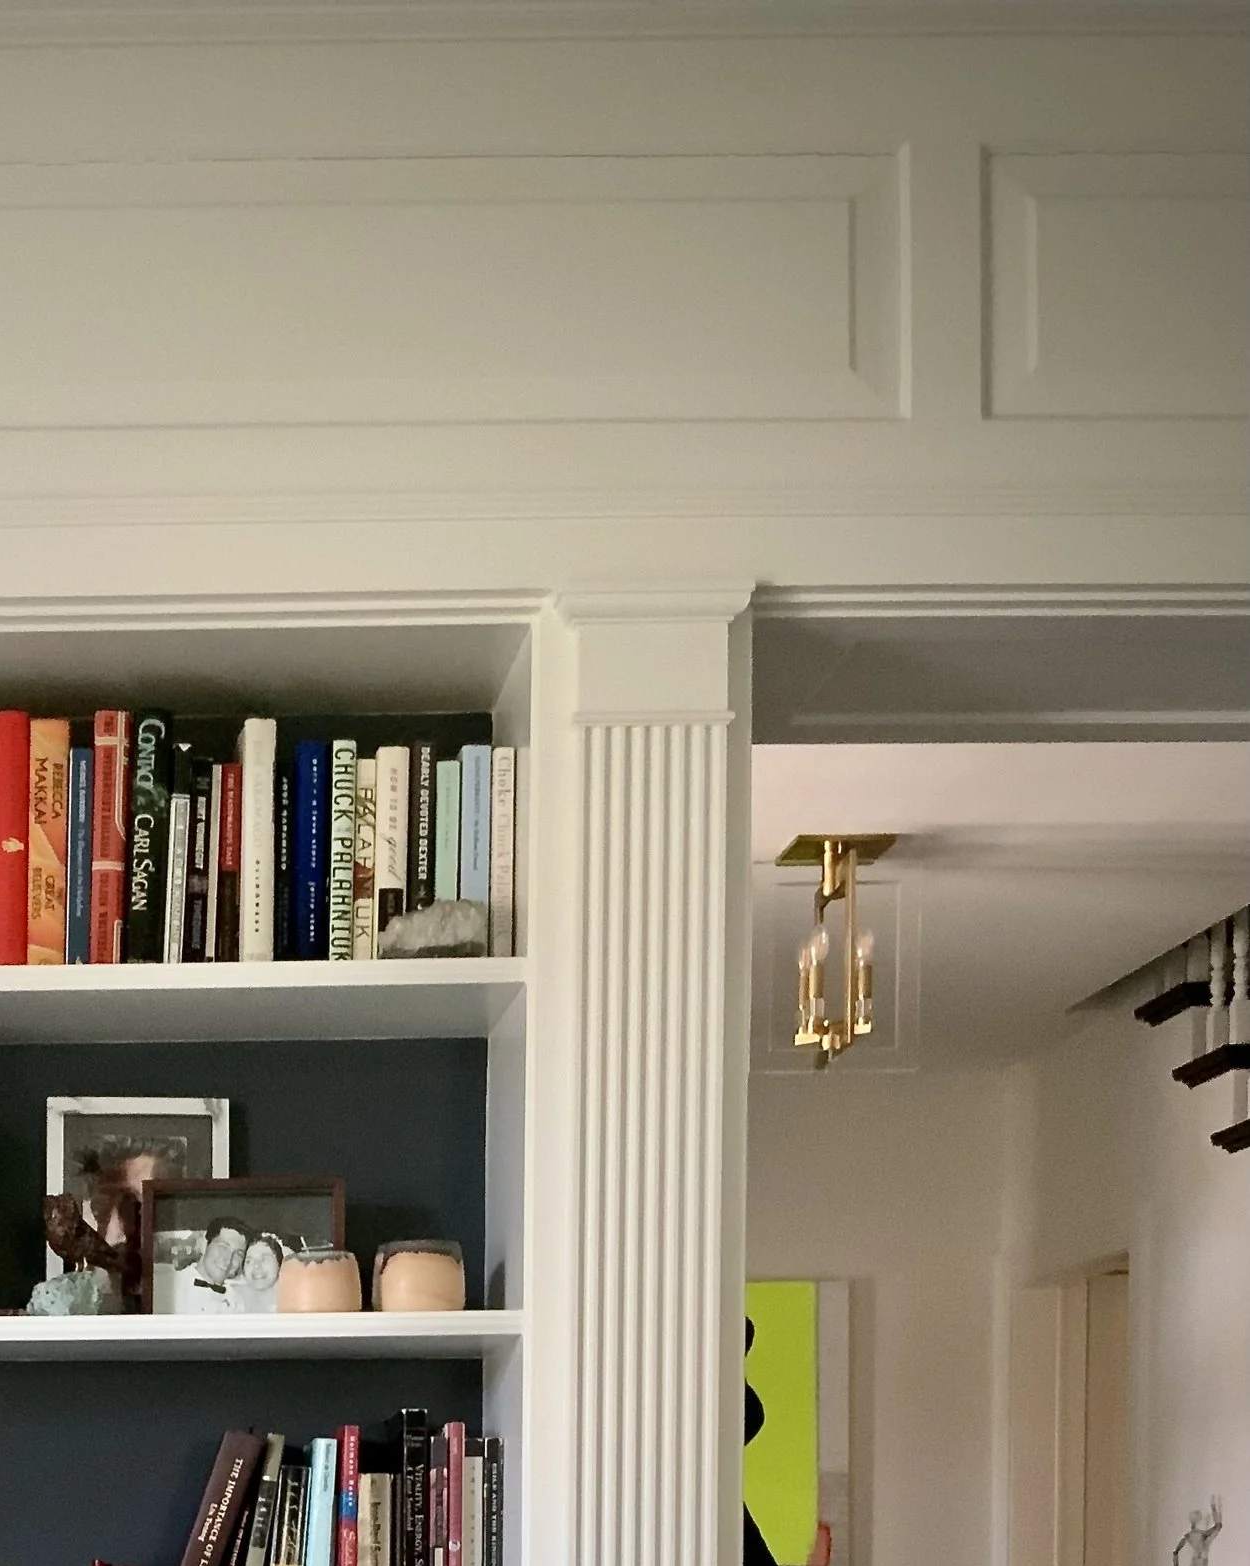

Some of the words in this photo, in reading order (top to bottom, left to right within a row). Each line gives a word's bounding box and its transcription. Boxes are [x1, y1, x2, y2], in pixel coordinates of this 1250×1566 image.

[333, 748, 355, 821] CHUCK
[420, 746, 430, 786] DEARLY
[497, 756, 512, 807] Choke
[34, 757, 48, 825] MAKKAI
[51, 763, 63, 819] REBECCA
[419, 789, 429, 836] DEVOTED
[133, 814, 154, 856] CARL
[418, 839, 428, 880] DEXTER
[45, 875, 55, 911] GREAT
[131, 859, 153, 910] SAGAN
[331, 837, 353, 961] PALAHNIUK
[230, 1458, 244, 1478] THE
[413, 1464, 424, 1511] VITALITY,
[208, 1480, 236, 1542] IMPORTANCE
[413, 1514, 424, 1555] ENERGY,
[203, 1543, 213, 1558] OF
